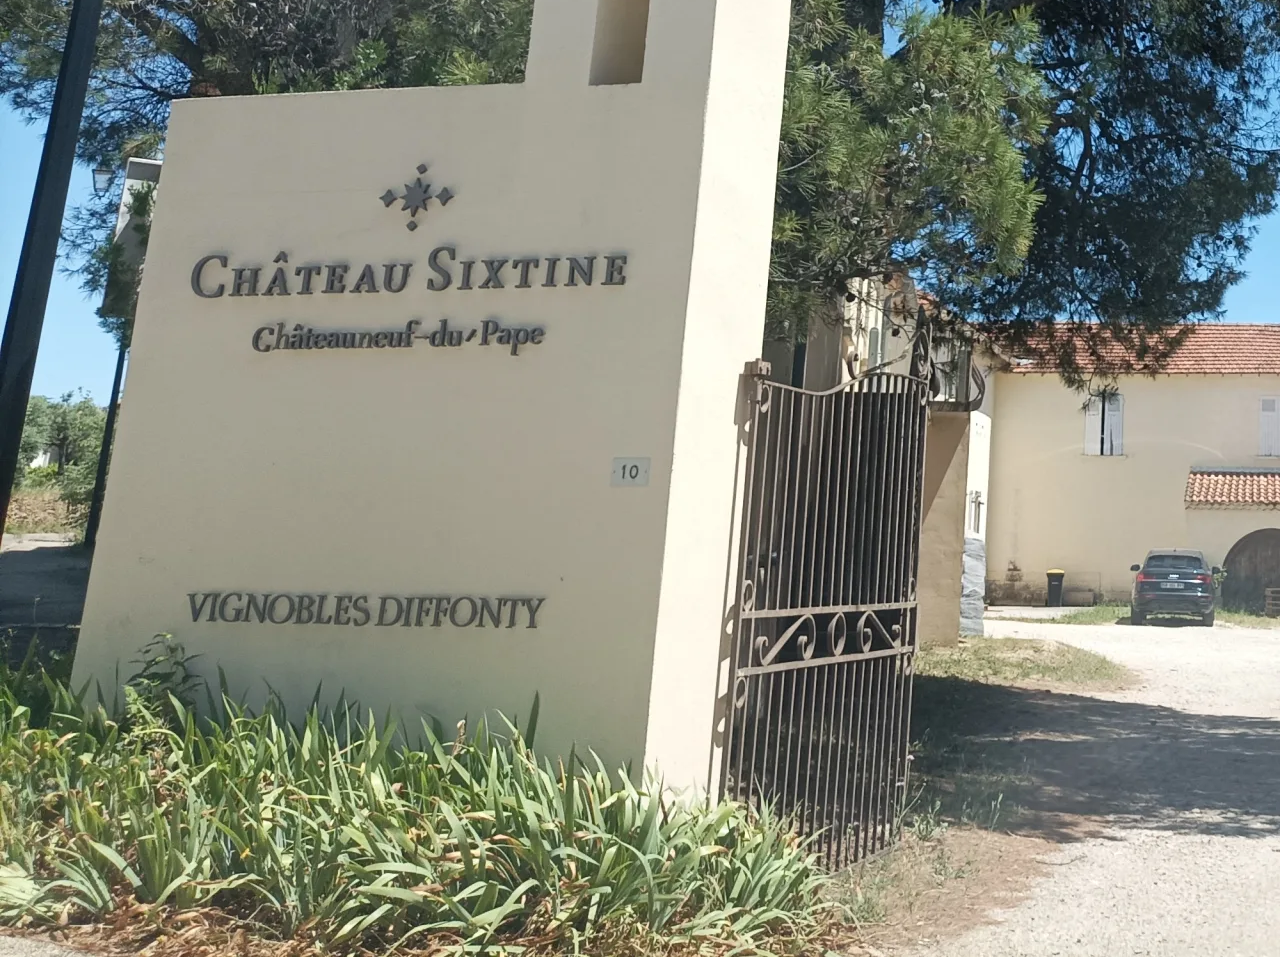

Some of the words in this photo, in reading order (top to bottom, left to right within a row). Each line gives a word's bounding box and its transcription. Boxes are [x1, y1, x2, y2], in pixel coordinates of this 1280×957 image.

[191, 250, 413, 299] CHÂTEAU
[426, 245, 628, 292] SIXTINE
[621, 464, 639, 479] 10
[187, 592, 371, 627] VIGNOBLES
[375, 595, 545, 630] DIFFONTY
